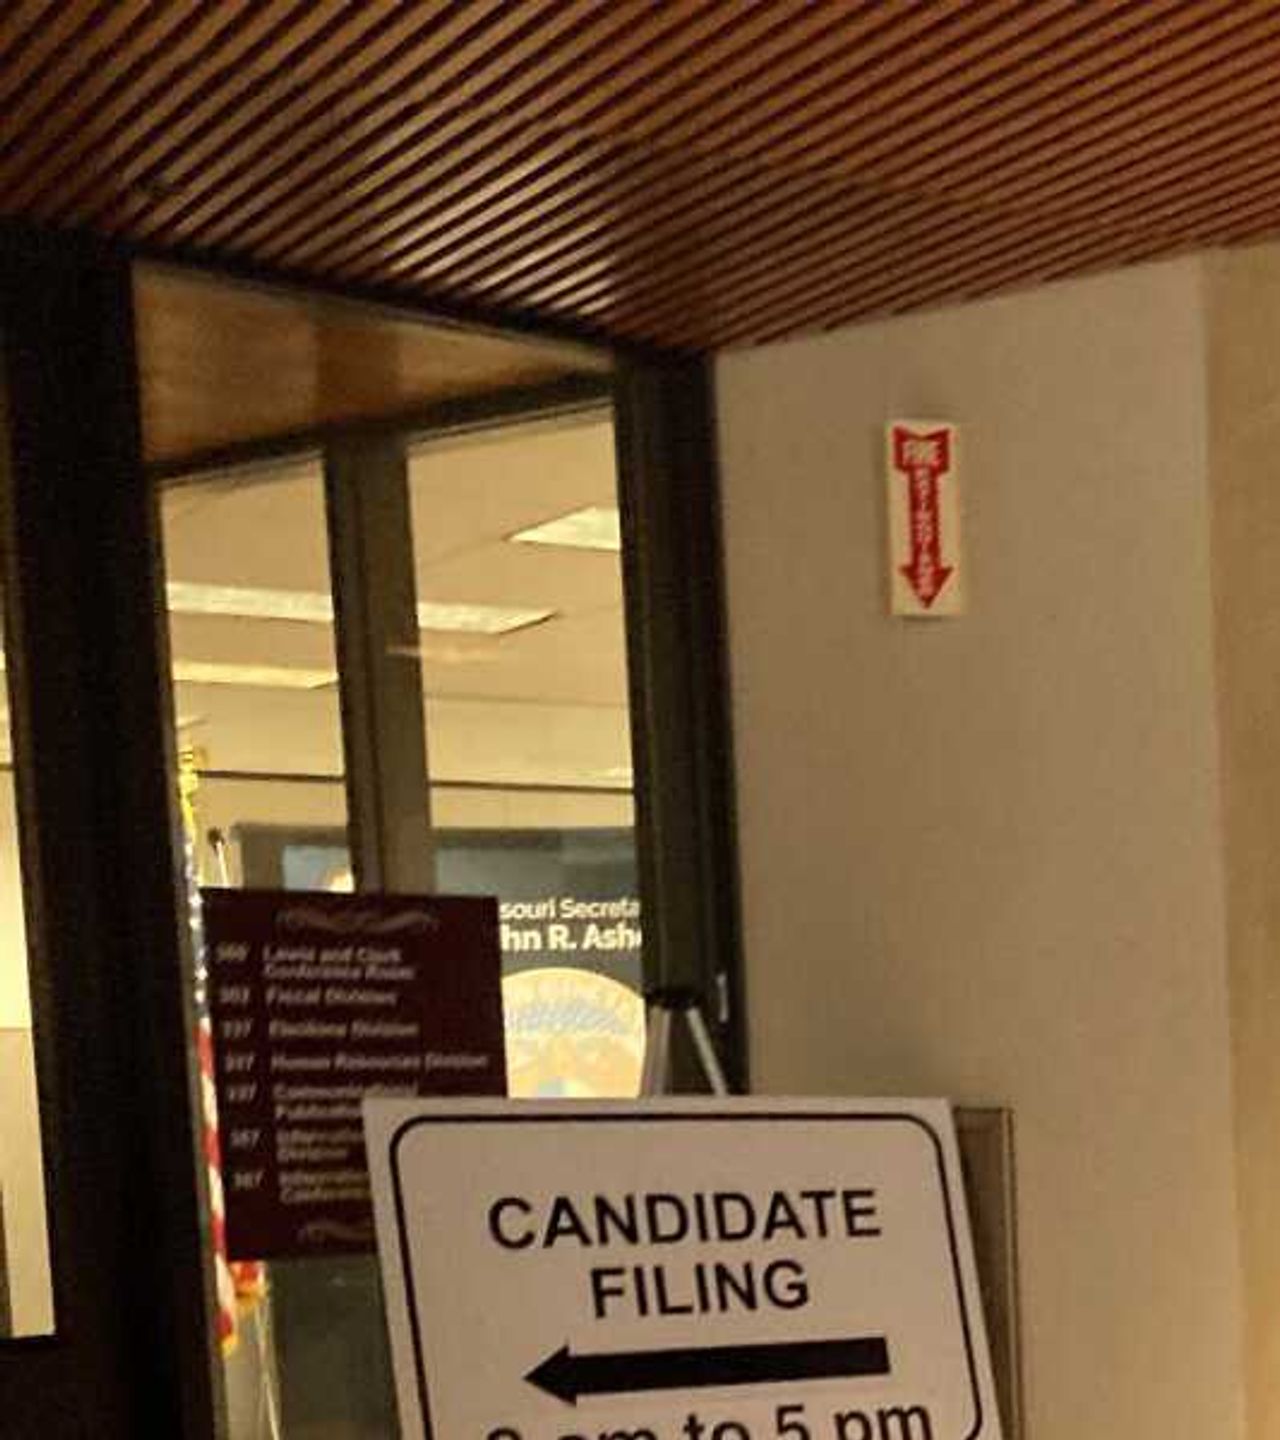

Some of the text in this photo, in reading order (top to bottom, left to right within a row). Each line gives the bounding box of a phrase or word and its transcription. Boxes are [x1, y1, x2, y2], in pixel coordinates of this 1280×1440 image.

[549, 923, 577, 950] R.
[488, 1188, 881, 1251] CANDIDATE
[589, 1259, 810, 1320] FILING
